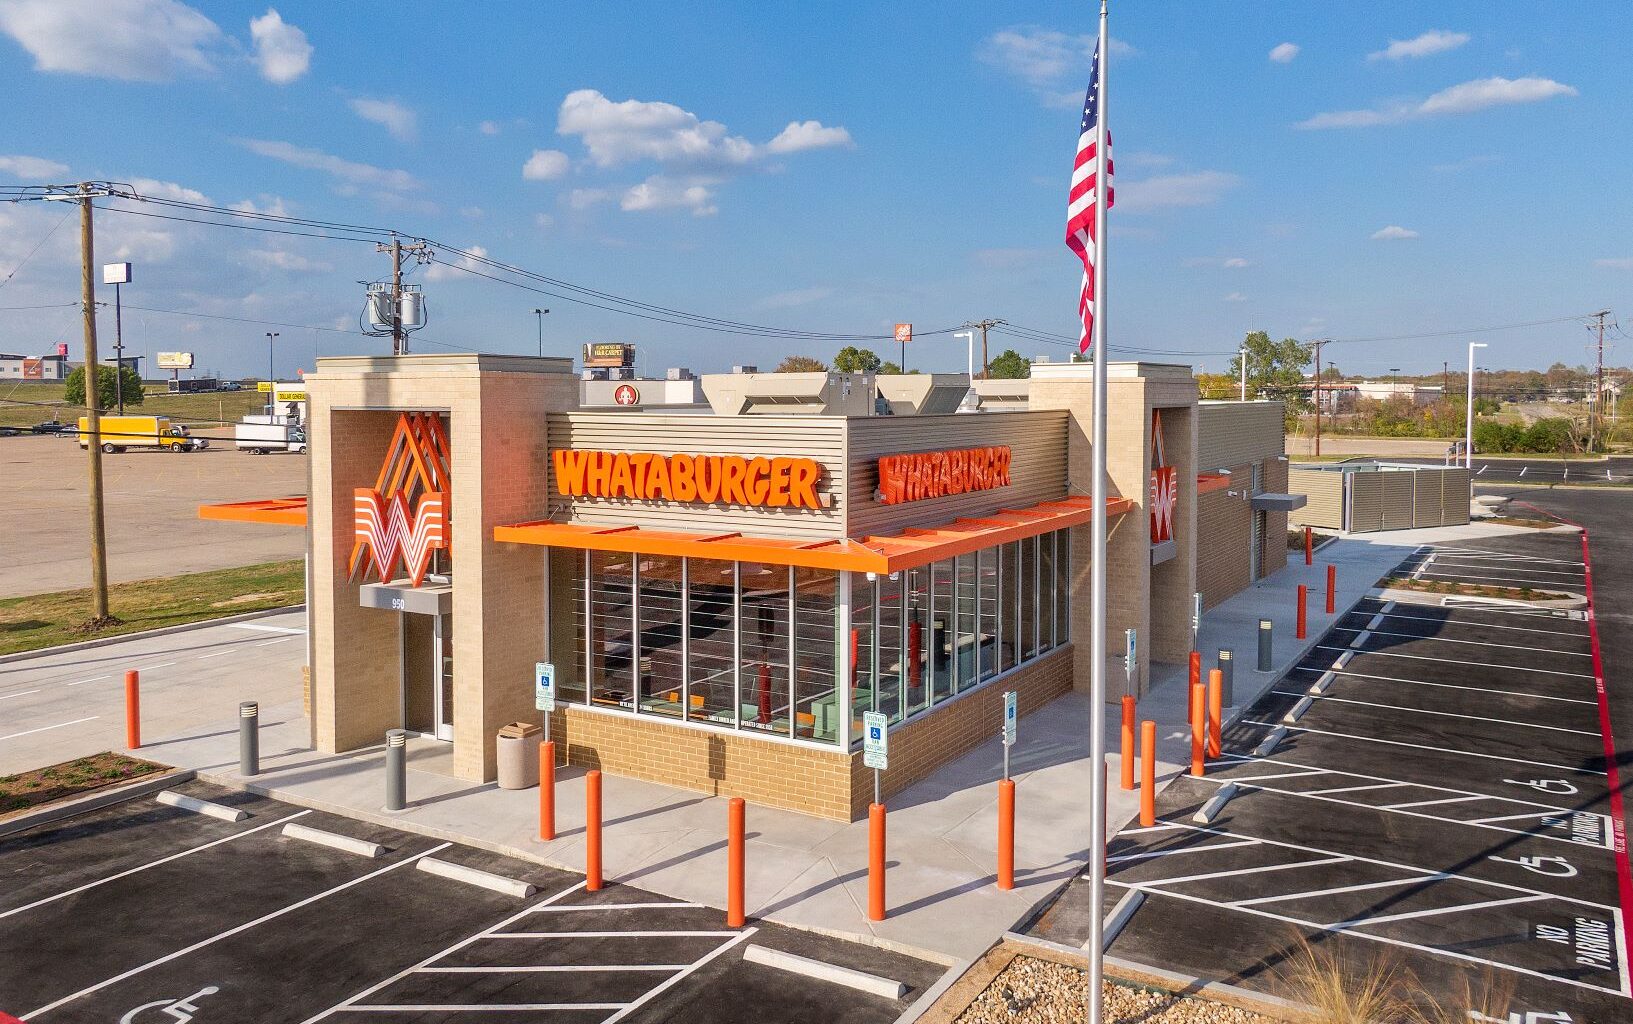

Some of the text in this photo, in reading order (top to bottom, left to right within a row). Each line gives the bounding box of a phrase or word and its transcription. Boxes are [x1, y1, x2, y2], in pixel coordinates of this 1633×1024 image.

[552, 450, 823, 510] WHATABURGER
[879, 446, 1011, 504] WHATABURGER
[391, 598, 405, 610] 950
[1536, 924, 1570, 945] NO
[1575, 917, 1612, 971] PARKING
